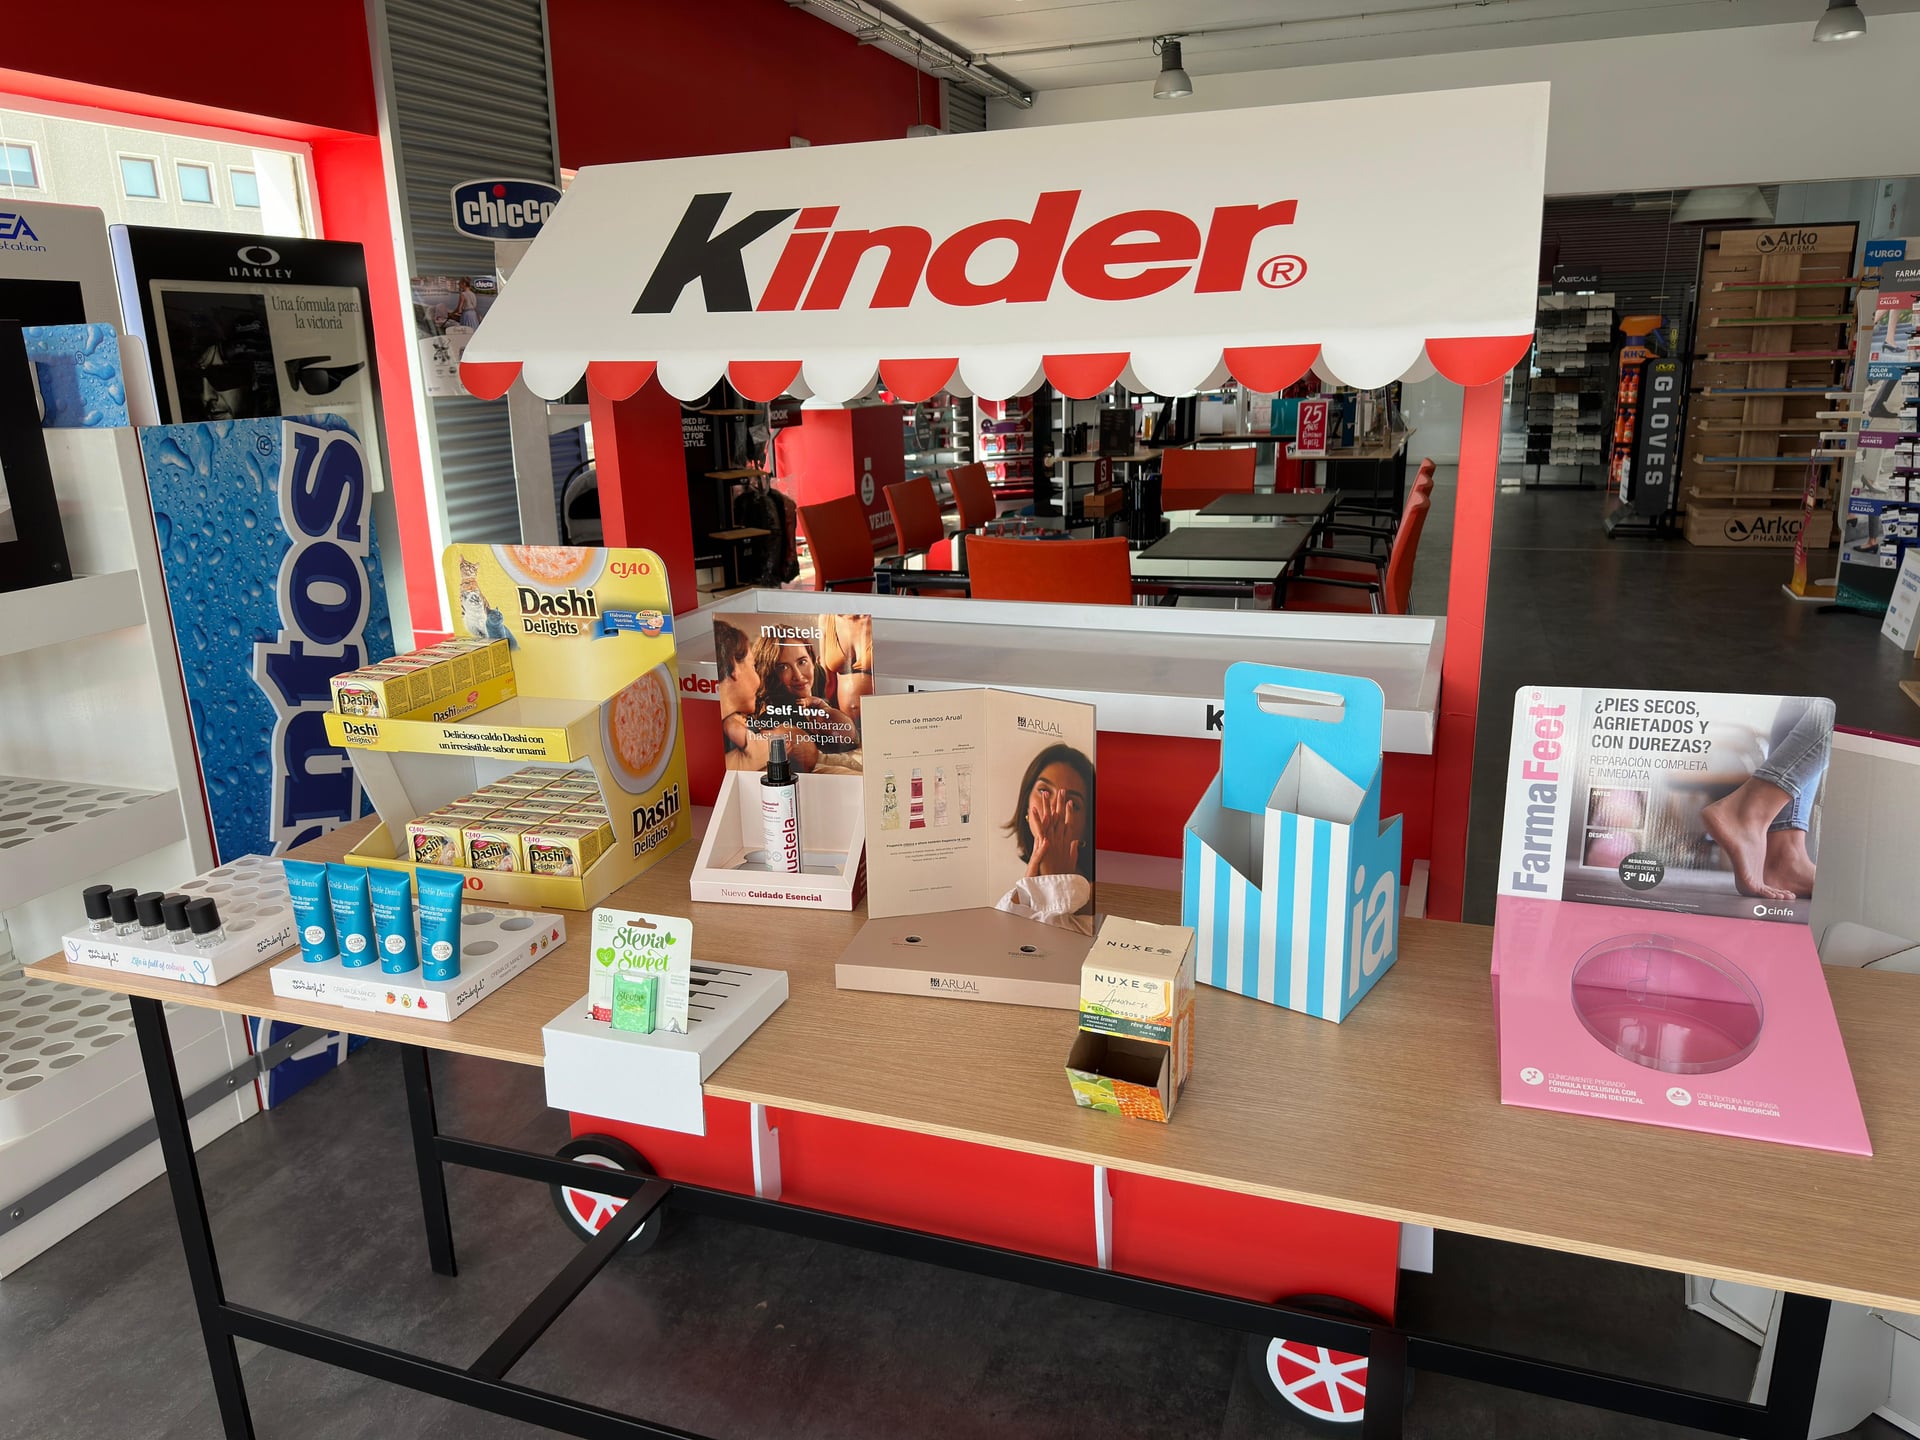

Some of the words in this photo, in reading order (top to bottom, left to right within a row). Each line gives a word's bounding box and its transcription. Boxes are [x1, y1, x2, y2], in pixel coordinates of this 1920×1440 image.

[462, 184, 557, 228] chicco
[1777, 230, 1818, 246] Arko
[632, 190, 1298, 314] Kinder
[1779, 245, 1816, 253] PHARMA
[1874, 250, 1903, 258] URGO
[229, 266, 293, 279] OAKLEY
[272, 296, 294, 312] Una
[295, 296, 336, 313] fórmula
[338, 300, 361, 316] para
[295, 313, 306, 329] la
[307, 315, 343, 330] victoria
[1303, 405, 1324, 426] 25
[1645, 376, 1674, 486] GLOVES
[1750, 516, 1802, 534] Arko
[610, 562, 651, 578] CIAO
[519, 587, 598, 618] Dashi
[523, 619, 578, 636] Delights
[760, 624, 823, 640] mustela
[341, 693, 373, 707] Dashi
[766, 705, 830, 719] Self-love,
[1595, 698, 1639, 714] ¿PIES
[1644, 699, 1700, 718] SECOS,
[343, 722, 379, 737] Dashi
[746, 717, 780, 729] desde
[783, 718, 793, 729] el
[796, 720, 852, 731] embarazo
[1027, 718, 1063, 734] ARUAL
[1593, 716, 1694, 734] AGRIETADOS
[1699, 720, 1709, 734] Y
[346, 735, 373, 745] Delights
[443, 730, 480, 740] Delicioso
[480, 733, 503, 741] caldo
[503, 733, 527, 743] Dashi
[796, 733, 855, 745] postparto.
[1592, 734, 1624, 749] CON
[1628, 736, 1712, 754] DUREZAS?
[450, 742, 491, 752] irresistible
[491, 745, 515, 753] sabor
[516, 748, 547, 756] umami
[1590, 755, 1652, 768] REPARACIÓN
[1654, 758, 1708, 771] COMPLETA
[1588, 767, 1595, 777] E
[1597, 768, 1650, 780] INMEDIATA
[1512, 703, 1566, 893] FarmaFeet
[632, 785, 680, 836] Dashi
[633, 825, 669, 859] Delights
[1588, 831, 1614, 840] DESPUÉS
[416, 836, 441, 861] Dashi
[471, 843, 502, 862] Dashi
[782, 818, 798, 873] ustela
[532, 849, 564, 862] Dashi
[1628, 858, 1657, 866] RESULTADOS
[1624, 871, 1637, 881] 3er
[1638, 871, 1656, 883] DÍA
[721, 889, 747, 899] Nuevo
[748, 890, 784, 900] Cuidado
[785, 892, 822, 902] Esencial
[598, 914, 614, 923] 300
[1768, 906, 1794, 917] cinfa
[612, 926, 666, 950] Stevia
[1107, 940, 1154, 952] NUXE
[617, 949, 670, 973] Sweet
[941, 980, 979, 991] ARUAL
[1094, 974, 1140, 988] NUXE
[1087, 1005, 1109, 1013] PELOS
[1110, 1009, 1138, 1018] NOSSOS
[1130, 1021, 1144, 1029] rêve
[1582, 1084, 1621, 1095] EXCLUSIVA
[1621, 1089, 1637, 1097] CON
[1594, 1078, 1626, 1089] PROBADO
[1549, 1086, 1590, 1097] CERAMIDAS
[1590, 1091, 1608, 1099] SKIN
[1608, 1094, 1645, 1105] IDENTICAL
[1697, 1092, 1712, 1100] CON
[1712, 1094, 1742, 1105] TEXTURA
[1755, 1101, 1778, 1110] GRASA
[1698, 1099, 1708, 1107] DE
